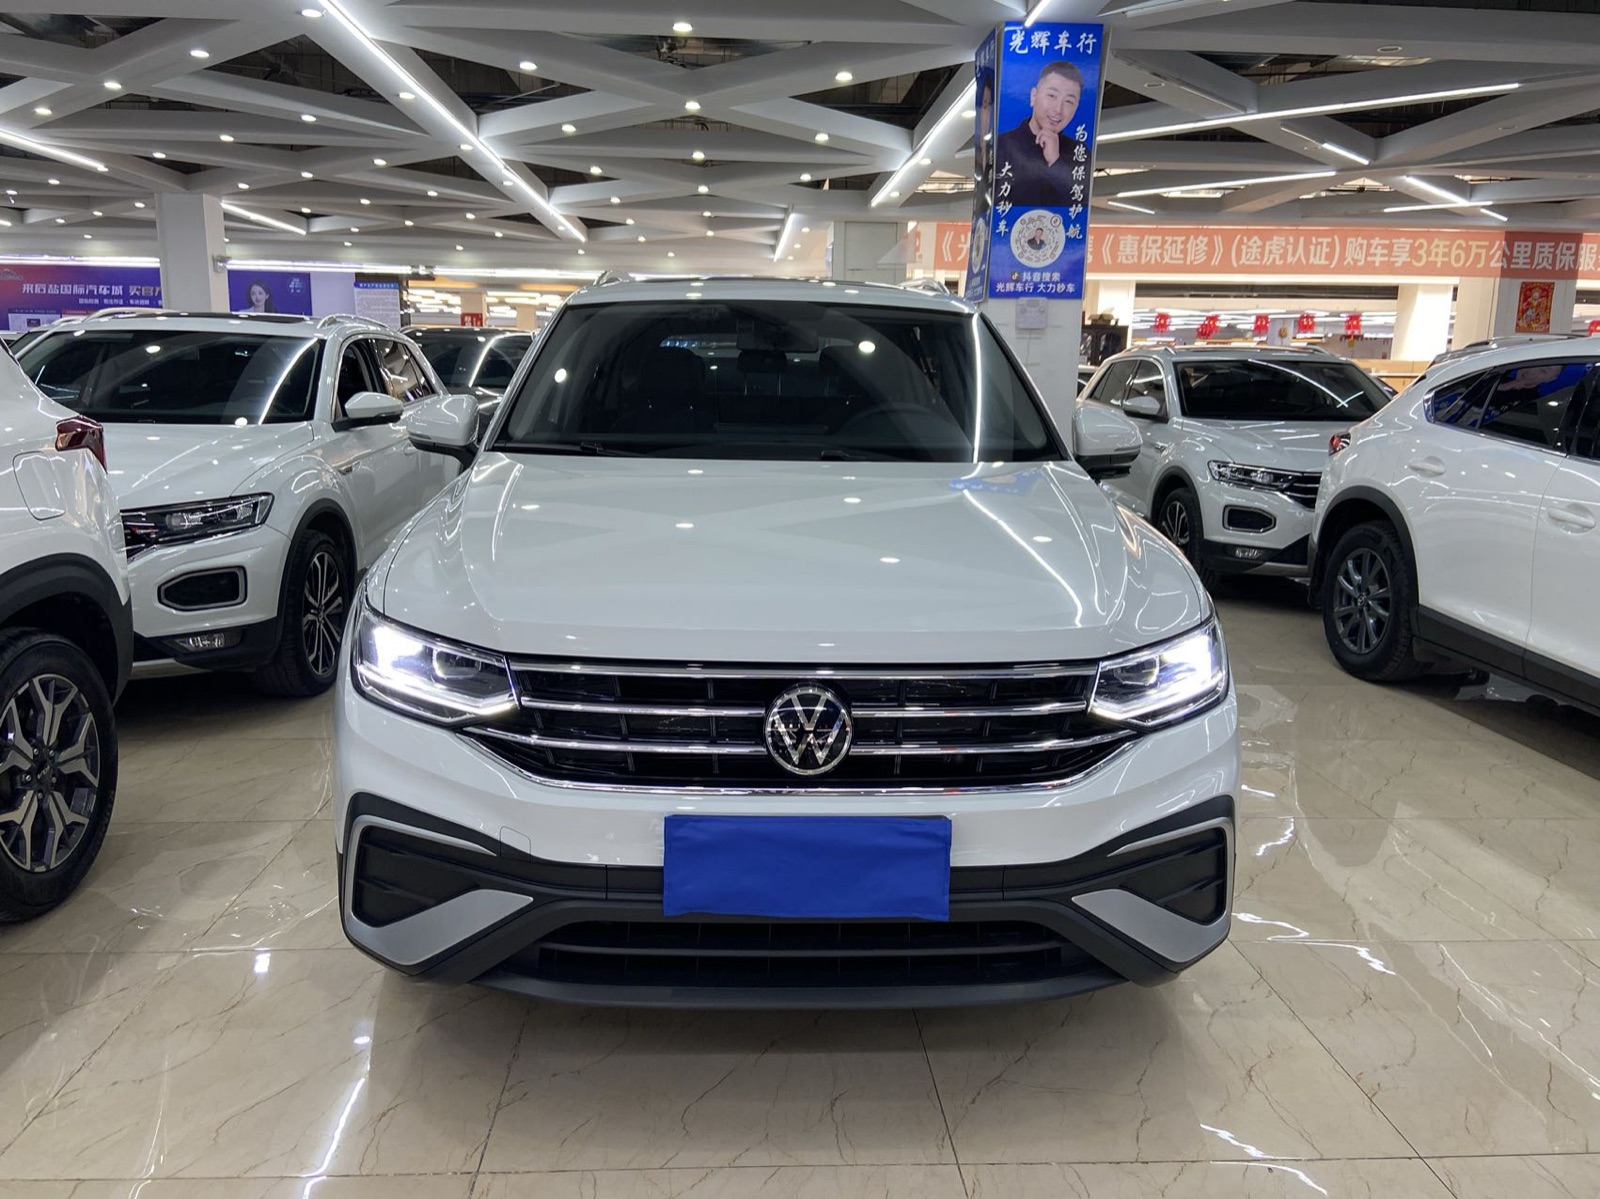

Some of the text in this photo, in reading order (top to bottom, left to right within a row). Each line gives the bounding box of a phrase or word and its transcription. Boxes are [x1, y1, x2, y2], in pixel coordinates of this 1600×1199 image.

[1009, 29, 1097, 56] 光辉车行
[1066, 123, 1088, 240] 为您保驾护航
[995, 161, 1013, 238] 大力秒车
[995, 282, 1034, 293] 光辉车行
[1037, 282, 1076, 294] 大力秒车
[1022, 271, 1061, 282] 抖音搜索
